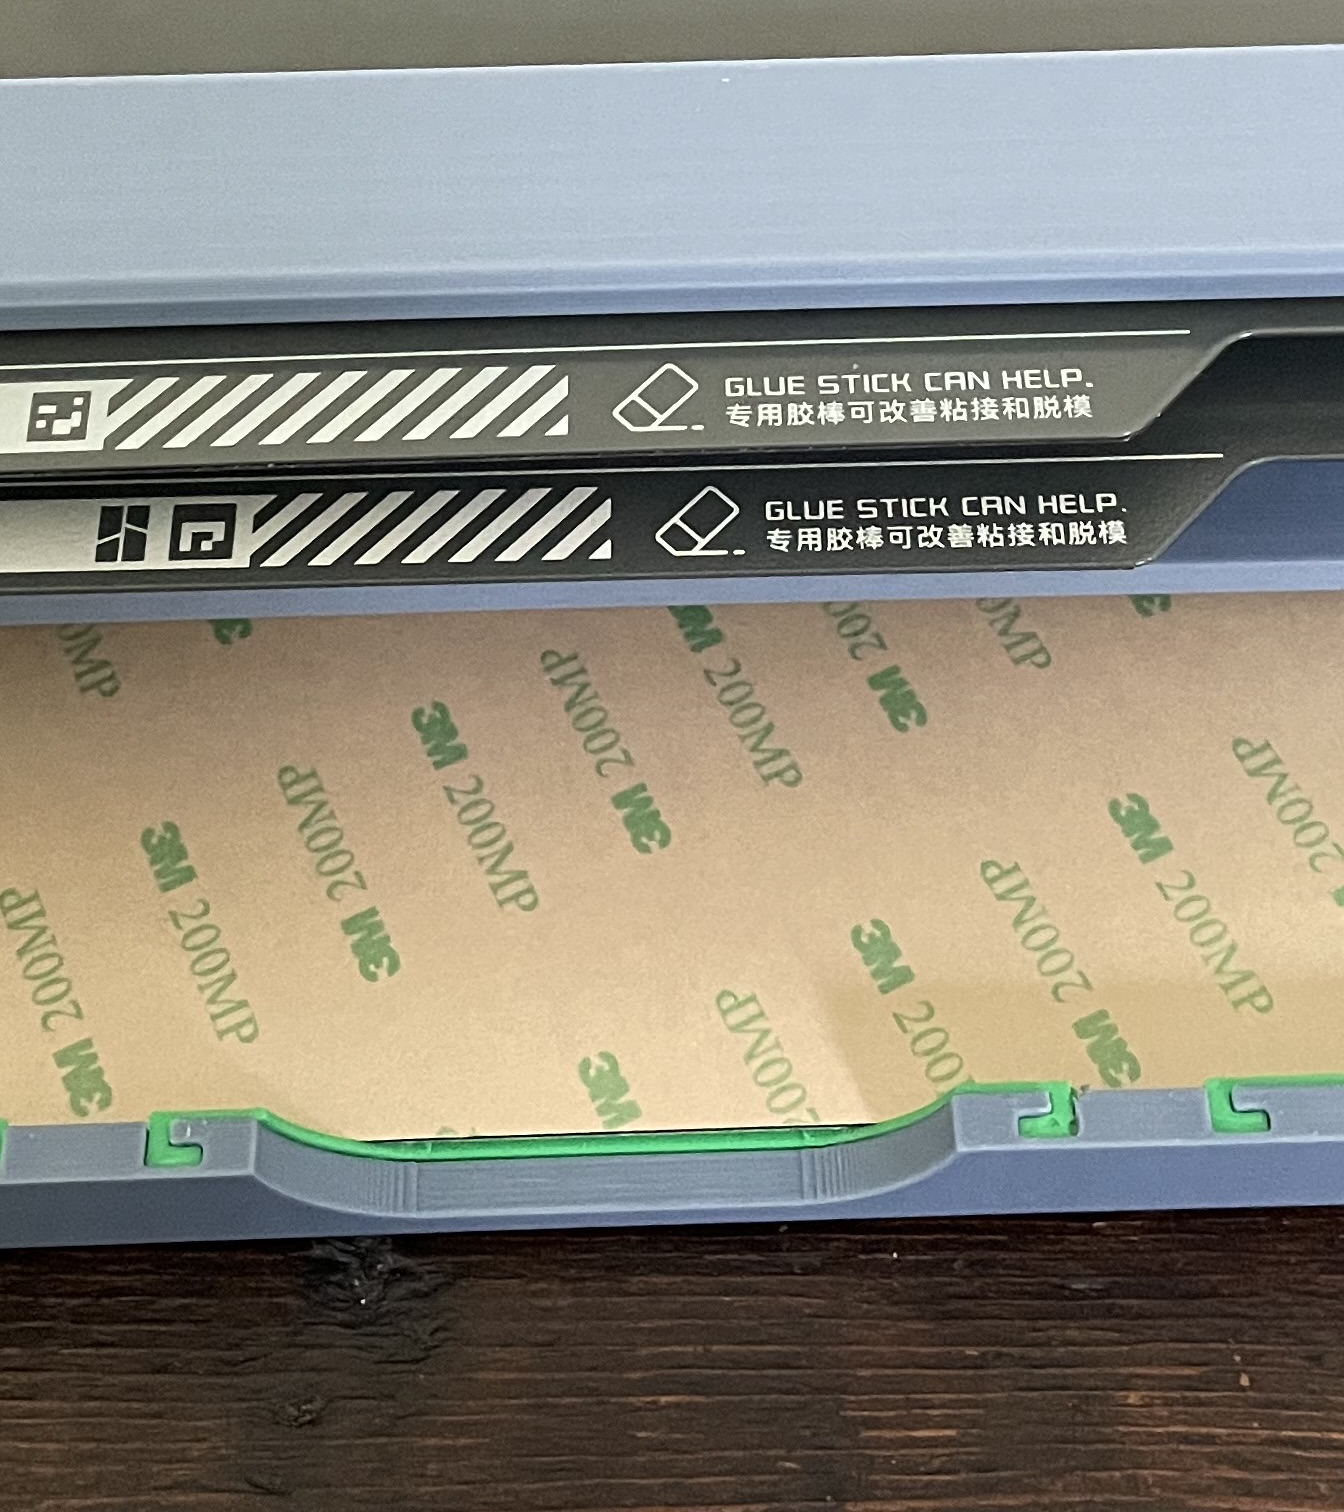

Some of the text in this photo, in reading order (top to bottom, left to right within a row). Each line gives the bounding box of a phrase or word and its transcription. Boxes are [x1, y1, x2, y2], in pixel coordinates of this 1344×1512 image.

[723, 369, 1095, 397] GLUE STICK CAN HELP.
[724, 394, 1094, 428] 专用胶棒可改善粘接和脱模
[764, 493, 1128, 521] GLUE STICK CAN HELP.
[766, 520, 1128, 553] 专用胶棒可改善粘接和脱模
[59, 624, 121, 699] 0MP
[822, 600, 928, 733] 3M 200
[975, 597, 1052, 670] 0MP
[540, 649, 672, 854] 3M 200MP
[703, 658, 803, 788] 200MP
[411, 701, 539, 913] 3M 200MP
[141, 821, 259, 1044] 3M 200MP
[277, 765, 401, 983] 3M 200MP
[1108, 793, 1274, 1014] 3M 200MP
[850, 918, 976, 1085] 3M 200
[980, 859, 1142, 1088] 3M 200MP
[53, 1038, 113, 1118] 3M
[579, 1051, 642, 1130] 3M
